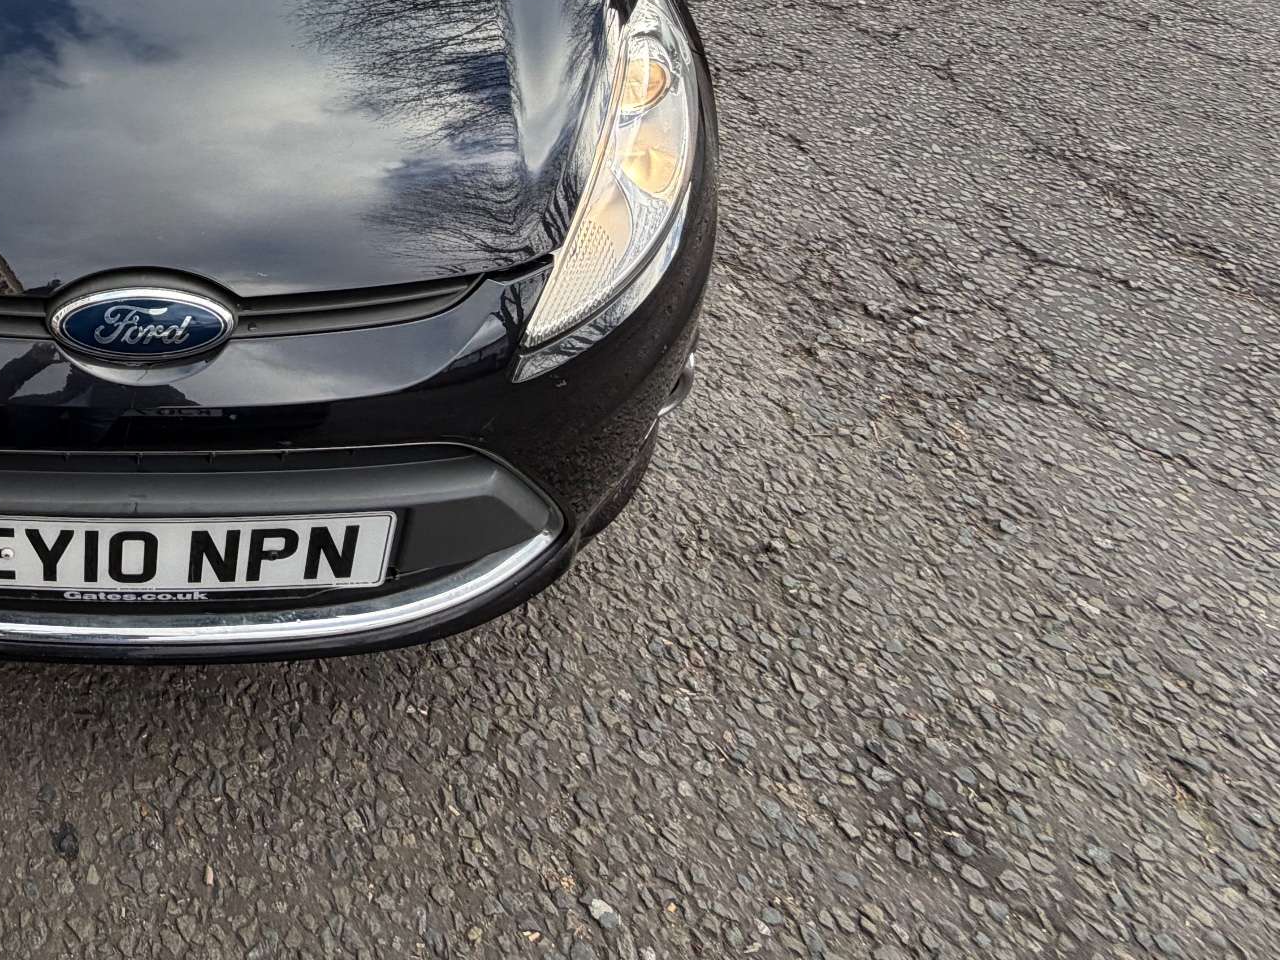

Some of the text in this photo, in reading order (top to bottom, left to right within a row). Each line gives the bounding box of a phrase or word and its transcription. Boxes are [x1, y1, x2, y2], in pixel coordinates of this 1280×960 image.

[94, 304, 193, 345] Ford
[187, 525, 360, 583] NPN
[63, 591, 208, 602] Gates.co.uk
